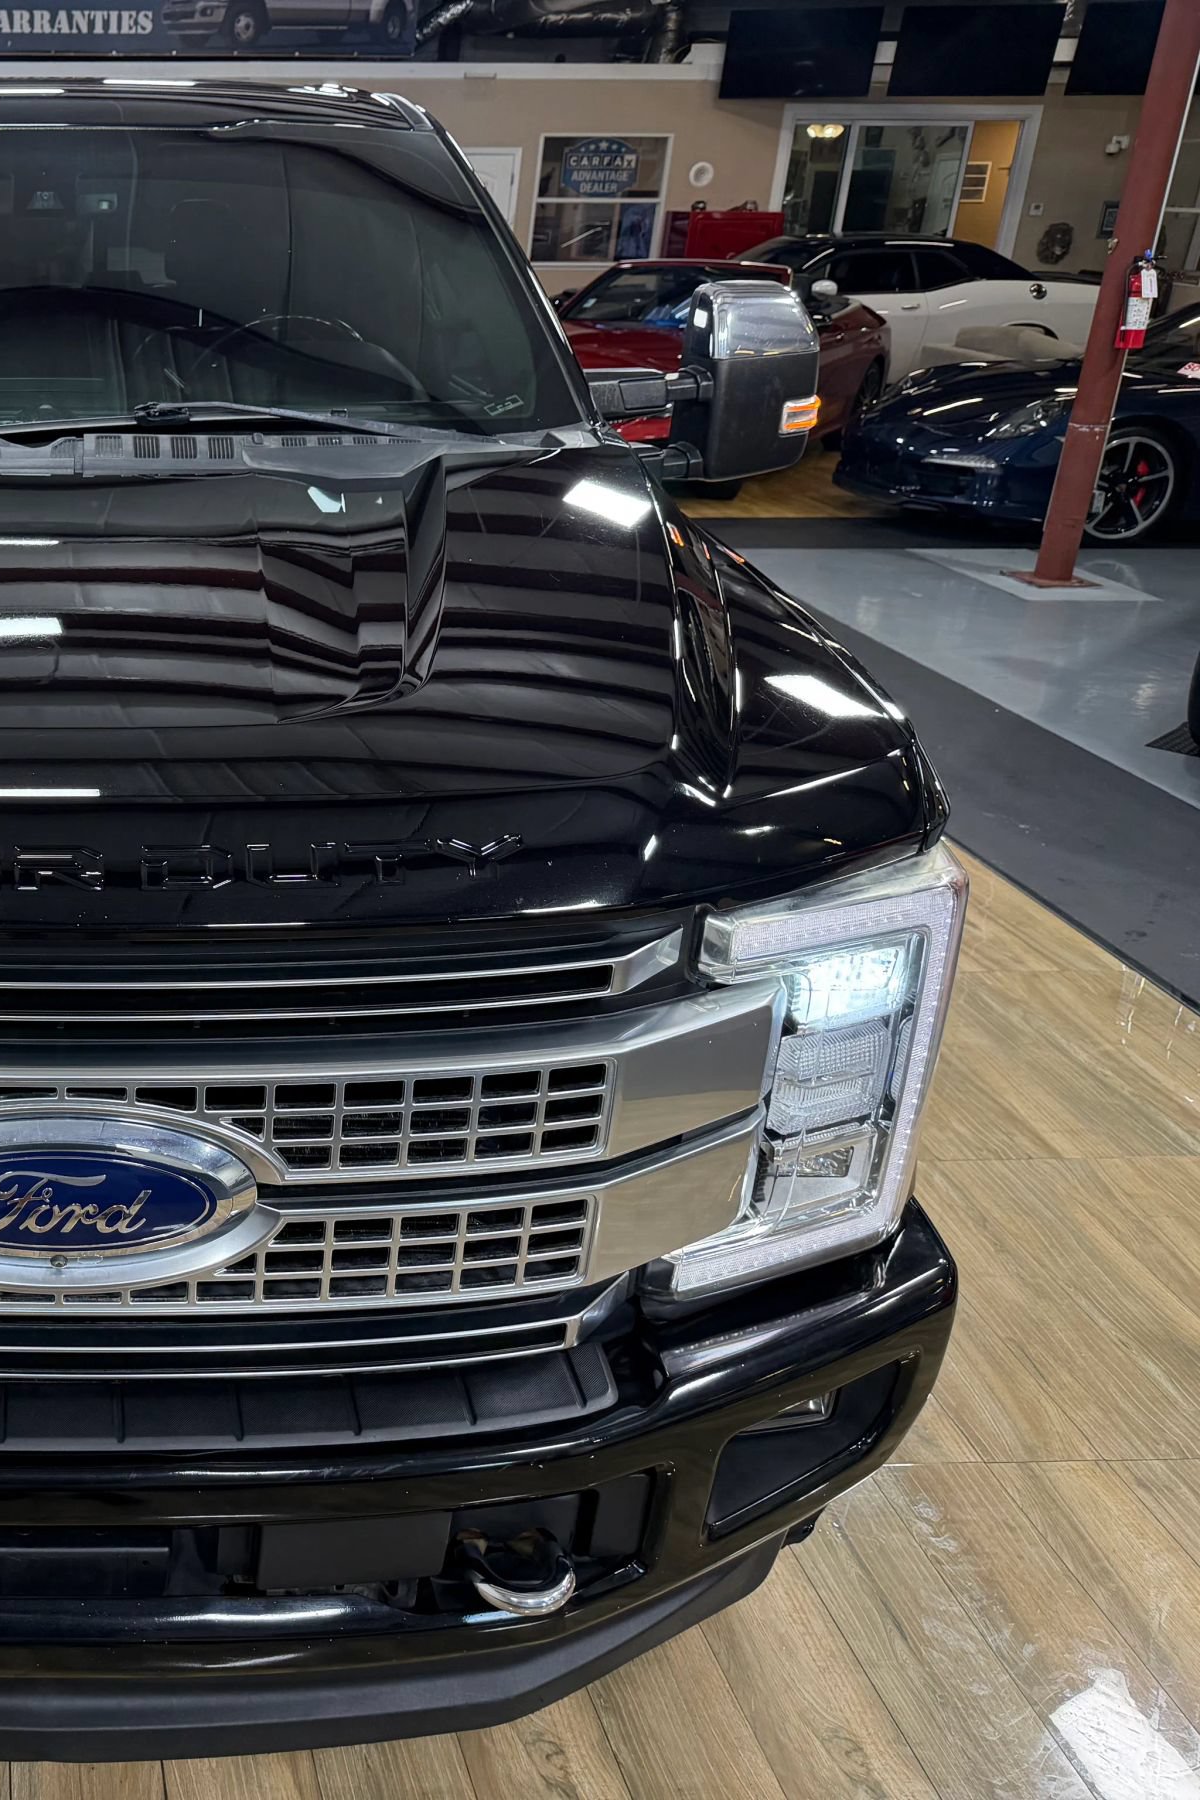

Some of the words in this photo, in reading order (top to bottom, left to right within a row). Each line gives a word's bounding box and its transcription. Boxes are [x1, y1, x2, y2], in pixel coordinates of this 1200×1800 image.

[569, 154, 637, 168] CARFAX
[571, 170, 629, 182] ADVANTAGE
[580, 181, 618, 193] DEALER
[140, 833, 523, 892] DUTY
